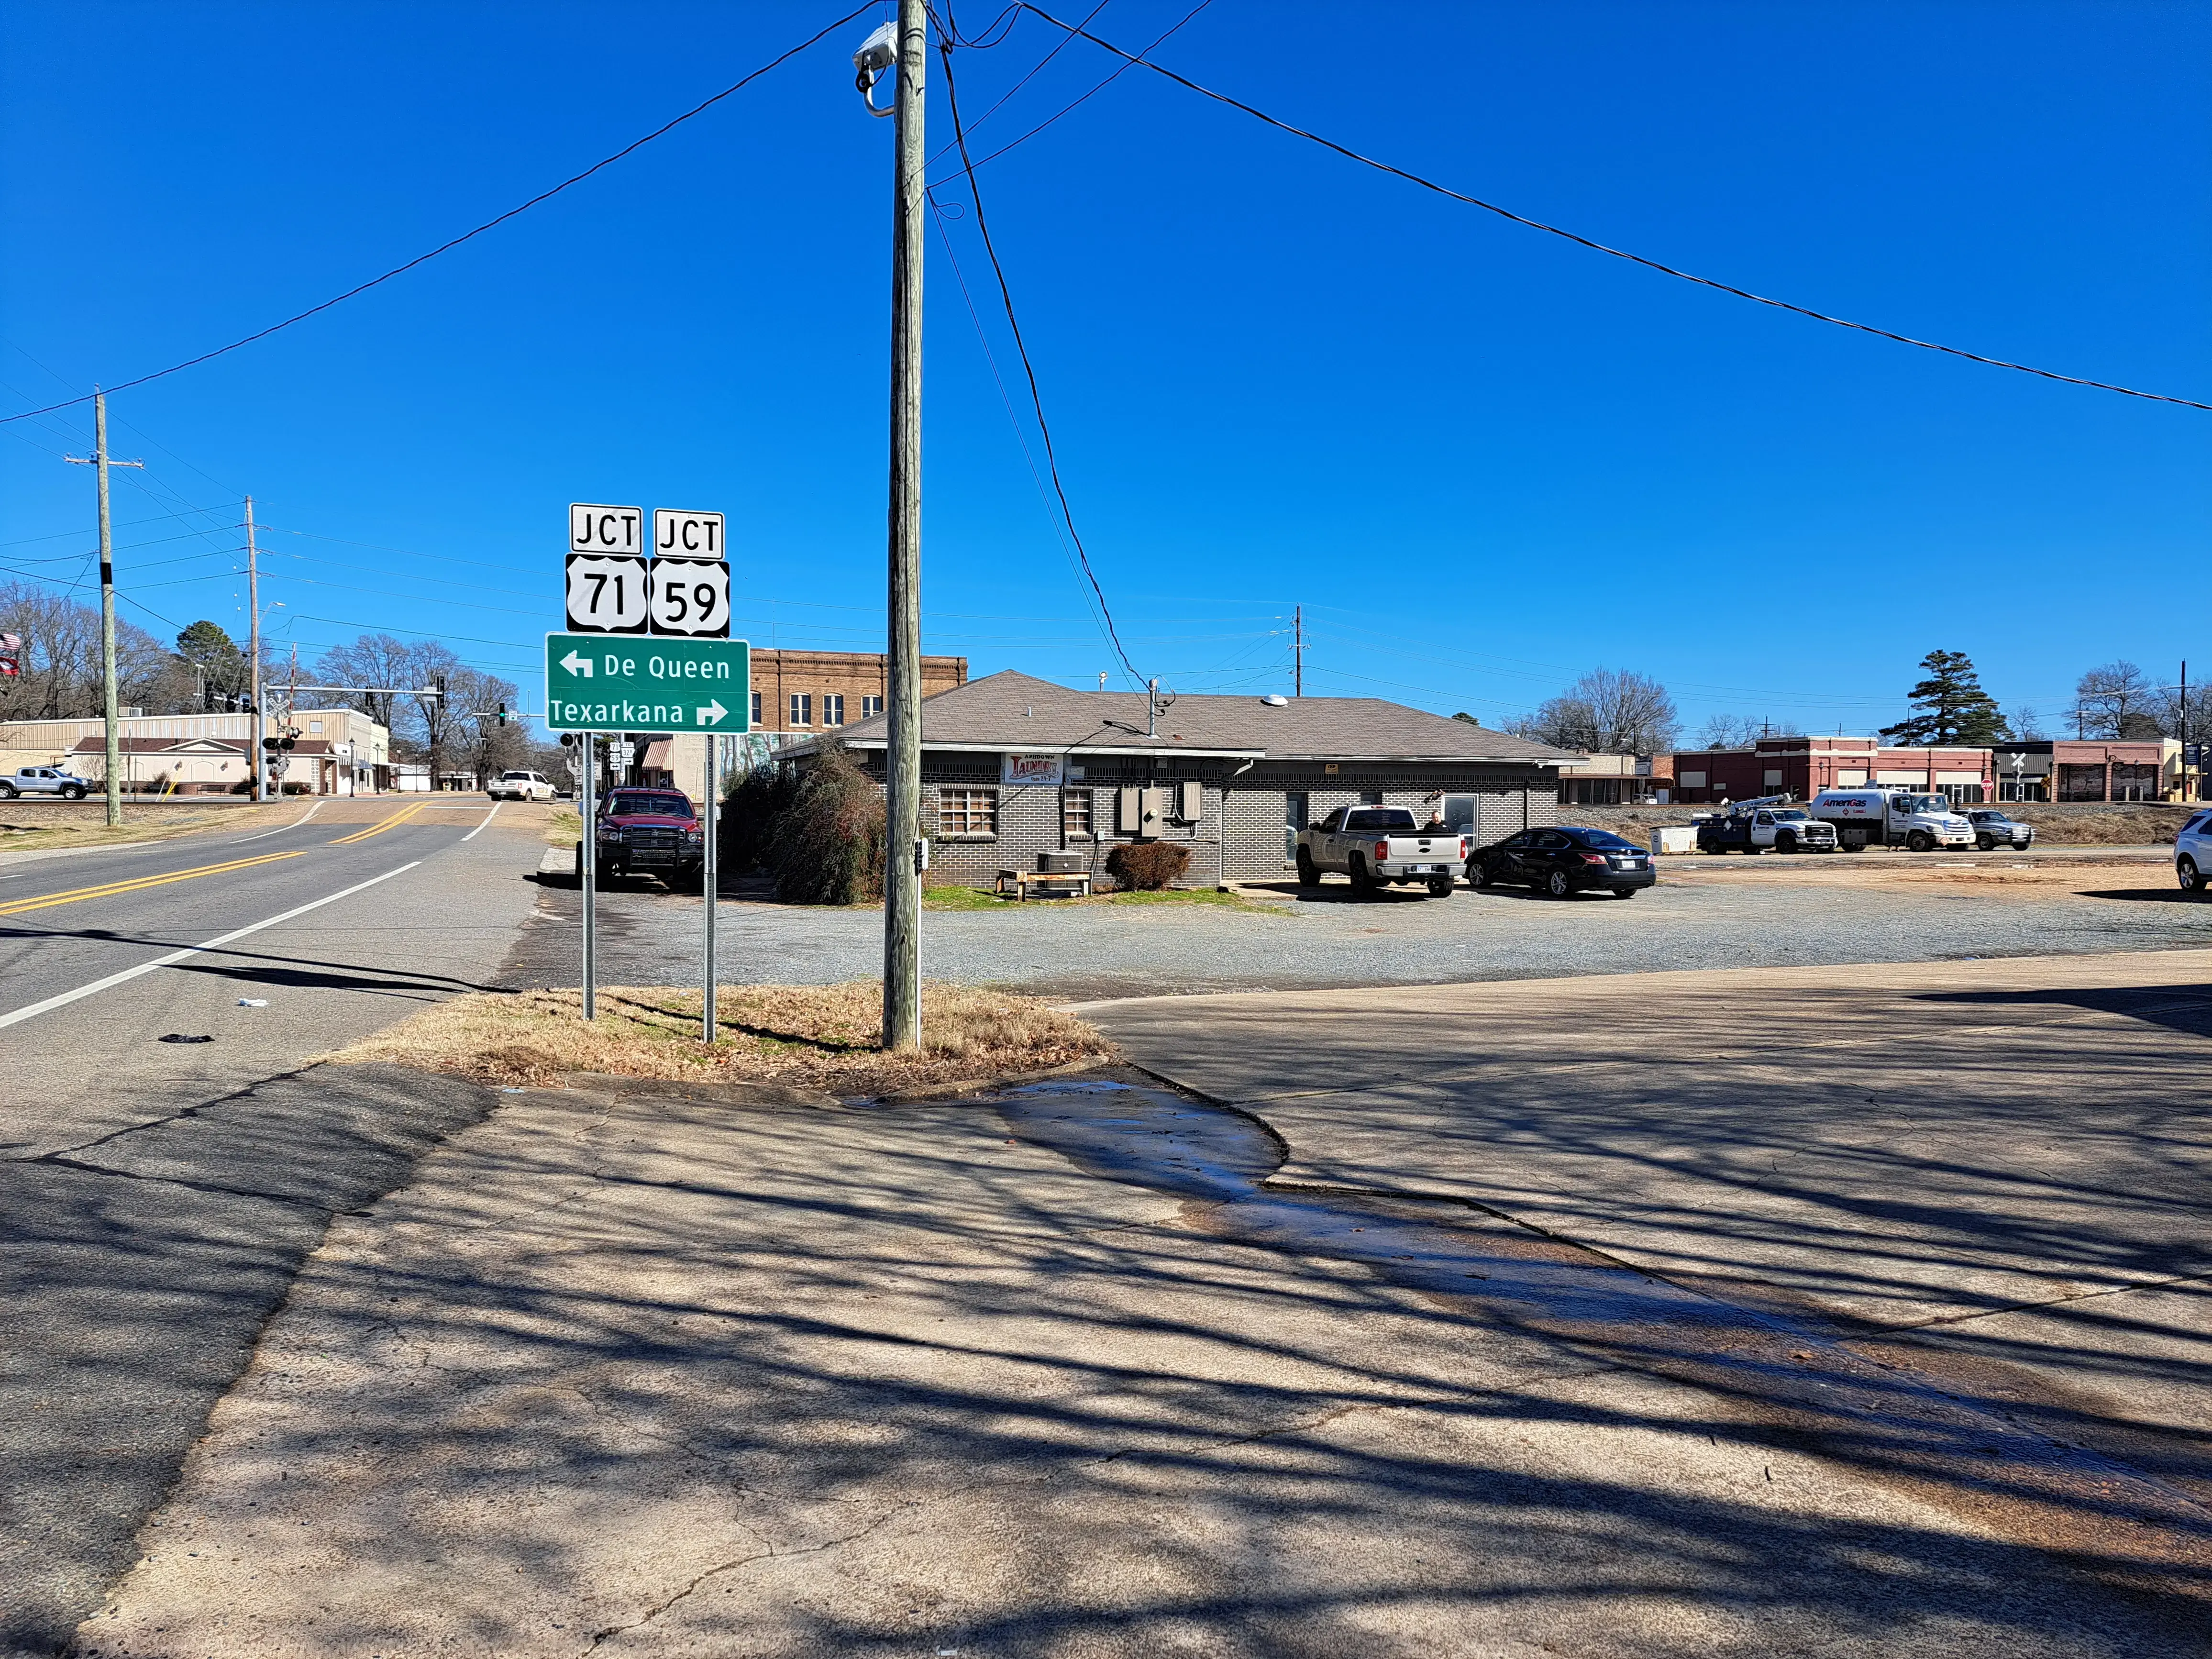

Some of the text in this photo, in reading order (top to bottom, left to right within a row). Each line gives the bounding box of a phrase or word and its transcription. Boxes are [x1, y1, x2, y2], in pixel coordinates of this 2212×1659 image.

[575, 513, 637, 546] JCT
[659, 519, 719, 551] JCT
[584, 573, 623, 615] 71
[665, 582, 716, 623] 59
[605, 654, 729, 680] De Queen
[550, 700, 683, 722] Texarkana
[1822, 798, 1867, 807] AmeriGas
